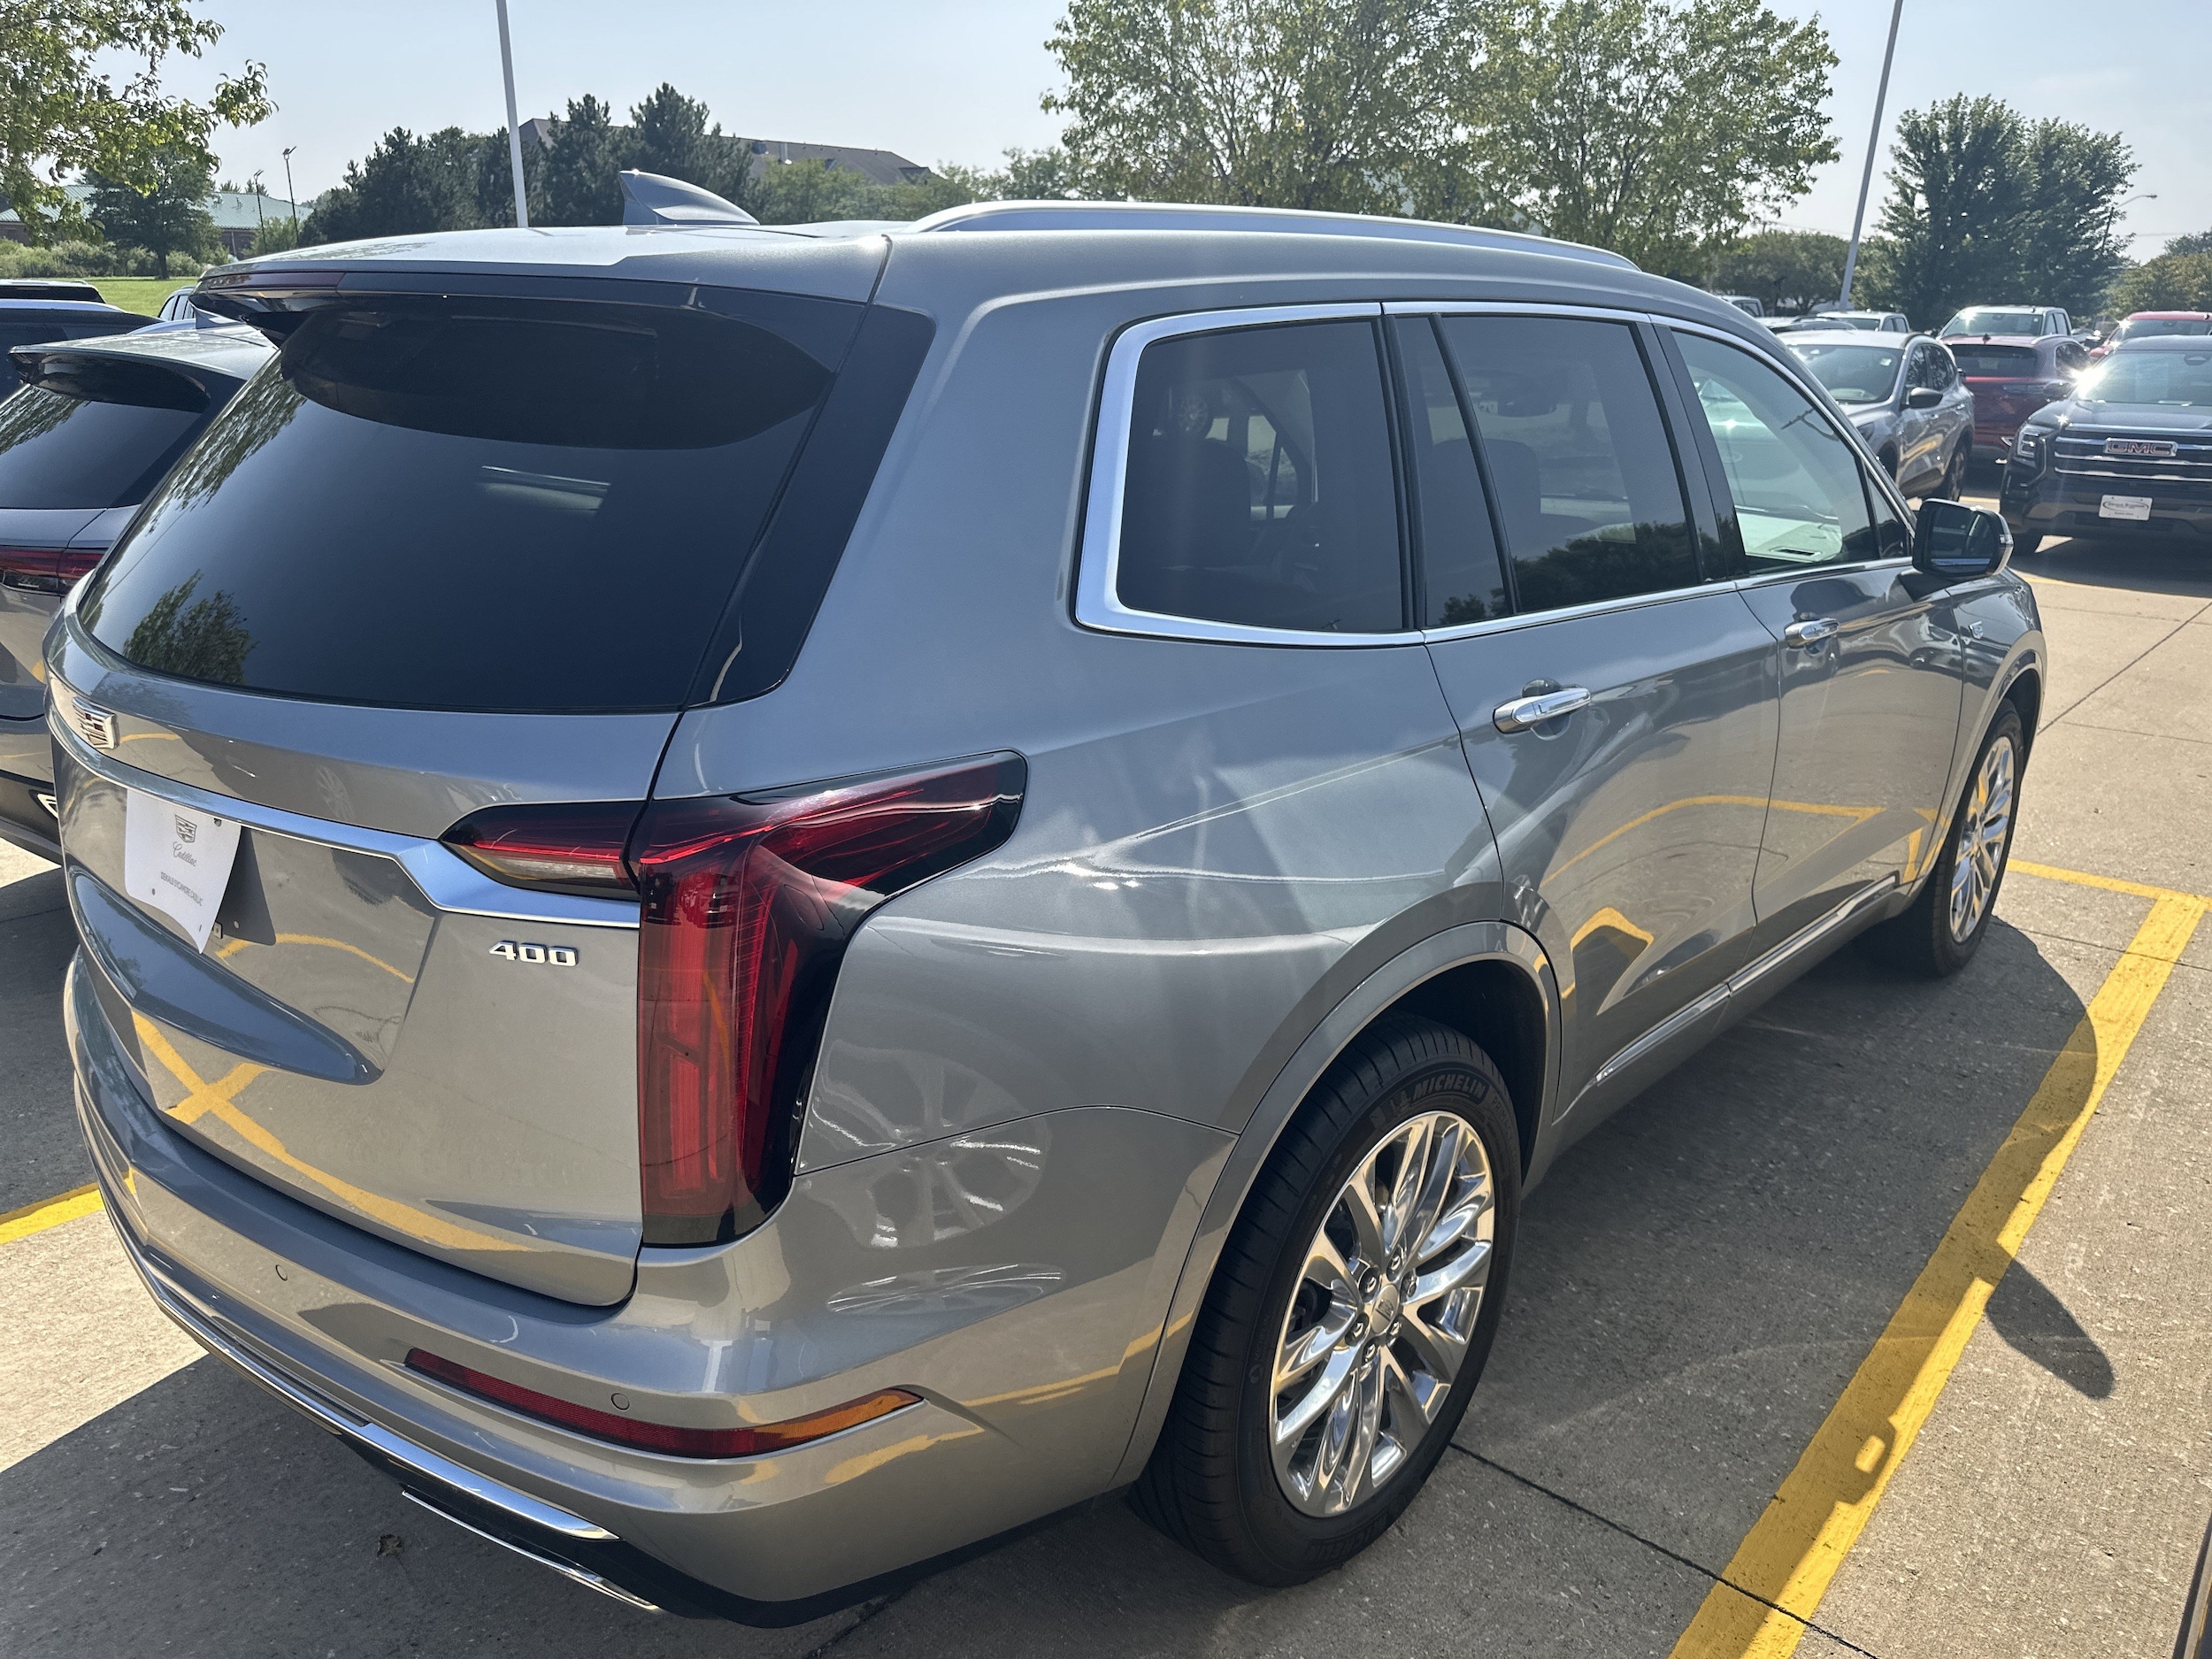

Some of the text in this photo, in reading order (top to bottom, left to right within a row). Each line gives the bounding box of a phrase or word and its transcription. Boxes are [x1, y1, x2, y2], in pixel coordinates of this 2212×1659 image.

[2108, 442, 2170, 456] GMC
[173, 841, 196, 866] Cadillac
[489, 941, 579, 967] 400
[1413, 1073, 1486, 1101] MICHELIN
